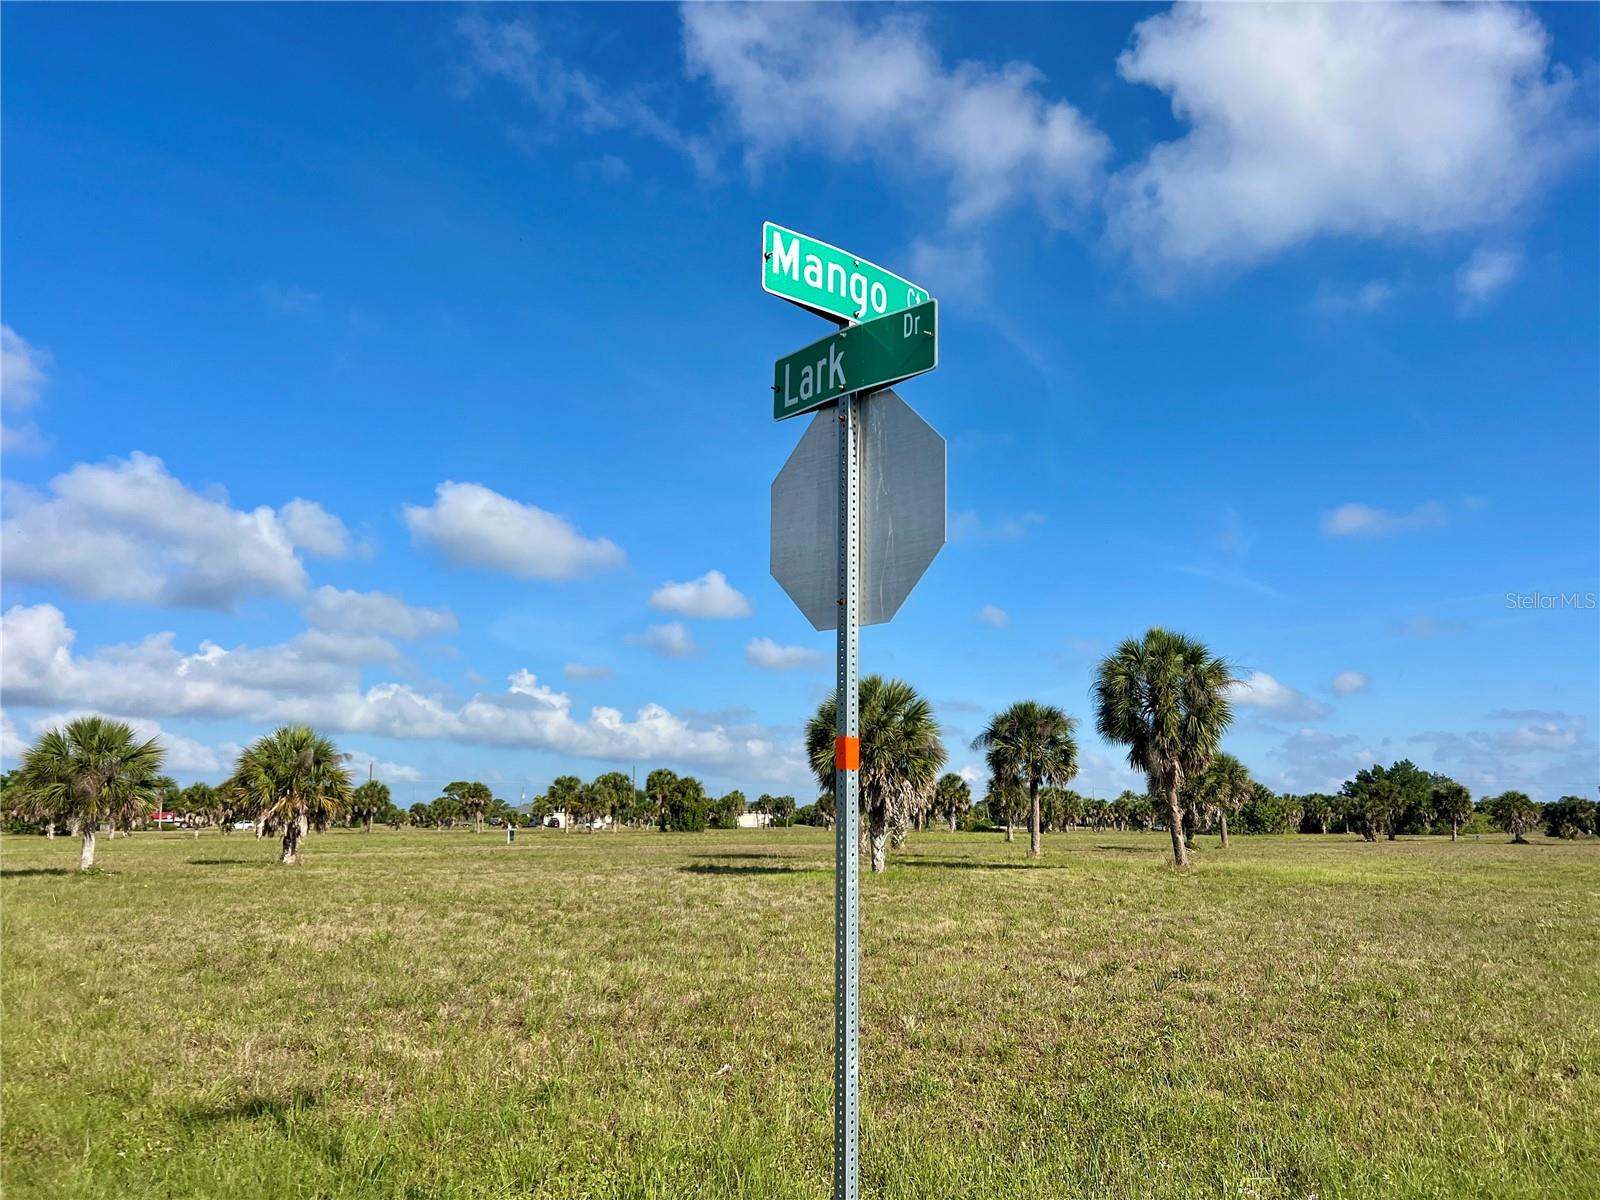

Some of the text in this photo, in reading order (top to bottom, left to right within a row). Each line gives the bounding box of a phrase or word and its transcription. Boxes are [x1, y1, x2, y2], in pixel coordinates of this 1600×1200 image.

[772, 231, 887, 317] Mango
[784, 313, 921, 408] Lark Dr
